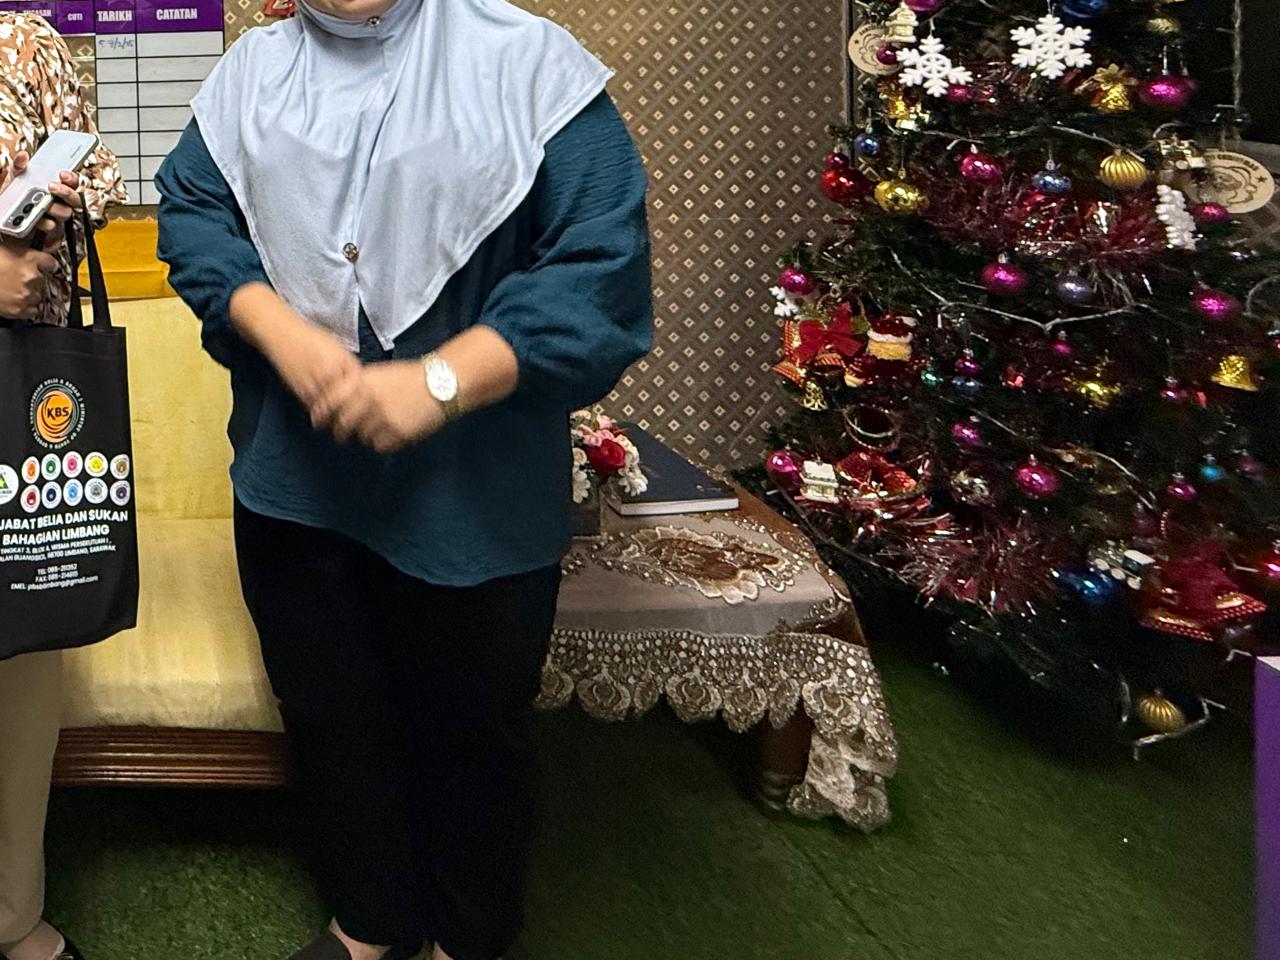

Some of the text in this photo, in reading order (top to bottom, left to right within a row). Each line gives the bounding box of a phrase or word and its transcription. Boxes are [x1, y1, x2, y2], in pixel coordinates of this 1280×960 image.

[67, 13, 83, 21] CUTI
[96, 10, 133, 22] TARIKH
[156, 8, 198, 21] CATATAN
[47, 406, 69, 420] KBS
[37, 514, 63, 529] BELIA
[65, 511, 87, 523] DAN
[89, 509, 128, 521] SUKAN
[2, 524, 109, 545] BAHAGIAN LIMBANG
